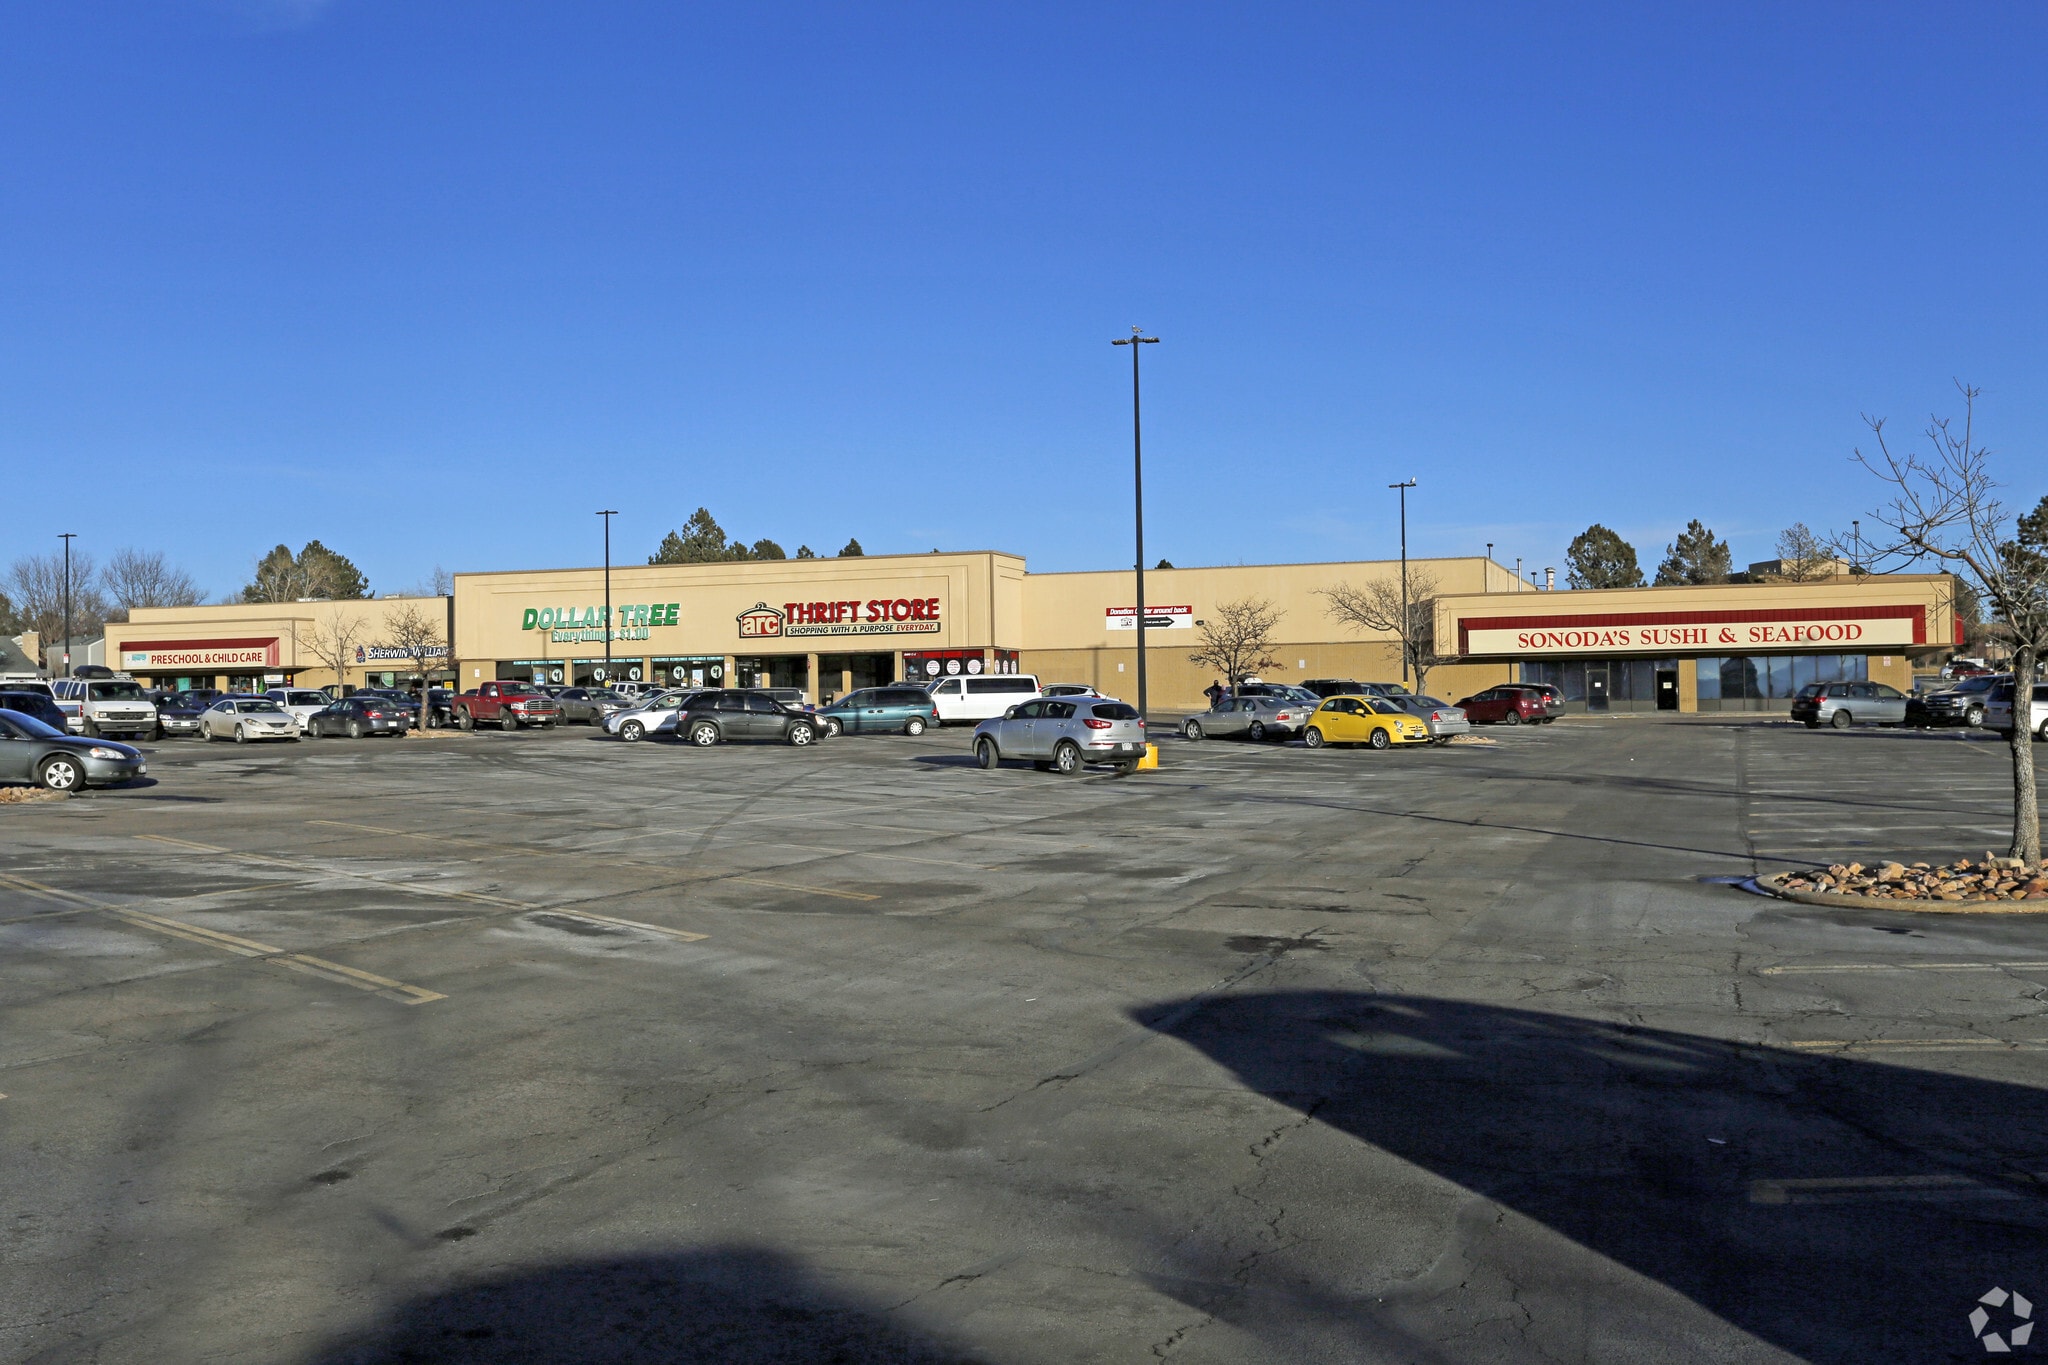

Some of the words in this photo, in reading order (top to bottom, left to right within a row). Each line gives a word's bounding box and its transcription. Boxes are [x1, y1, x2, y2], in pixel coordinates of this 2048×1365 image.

[522, 605, 613, 630] DOLLAR
[619, 603, 681, 627] TREE
[784, 601, 861, 624] THRIFT
[867, 598, 940, 622] STORE
[1110, 607, 1134, 615] Donation
[1134, 606, 1152, 614] Cter
[1152, 606, 1173, 614] around
[1173, 605, 1188, 613] back
[742, 616, 778, 635] arc
[789, 626, 829, 635] SHOPPING
[831, 625, 850, 634] WITH
[852, 625, 858, 633] A
[859, 624, 893, 633] PURPOSE
[896, 623, 935, 632] EVERYDAY.
[552, 629, 615, 644] Everythings
[619, 627, 650, 640] $1.00
[1518, 630, 1630, 648] SONODA'S
[1640, 628, 1708, 645] SUSHI
[1718, 627, 1737, 643] &
[1749, 624, 1862, 643] SEAFOOD
[151, 654, 204, 664] PRESCHOOL
[205, 655, 211, 663] &
[212, 653, 239, 663] CHILD
[239, 652, 262, 662] CARE
